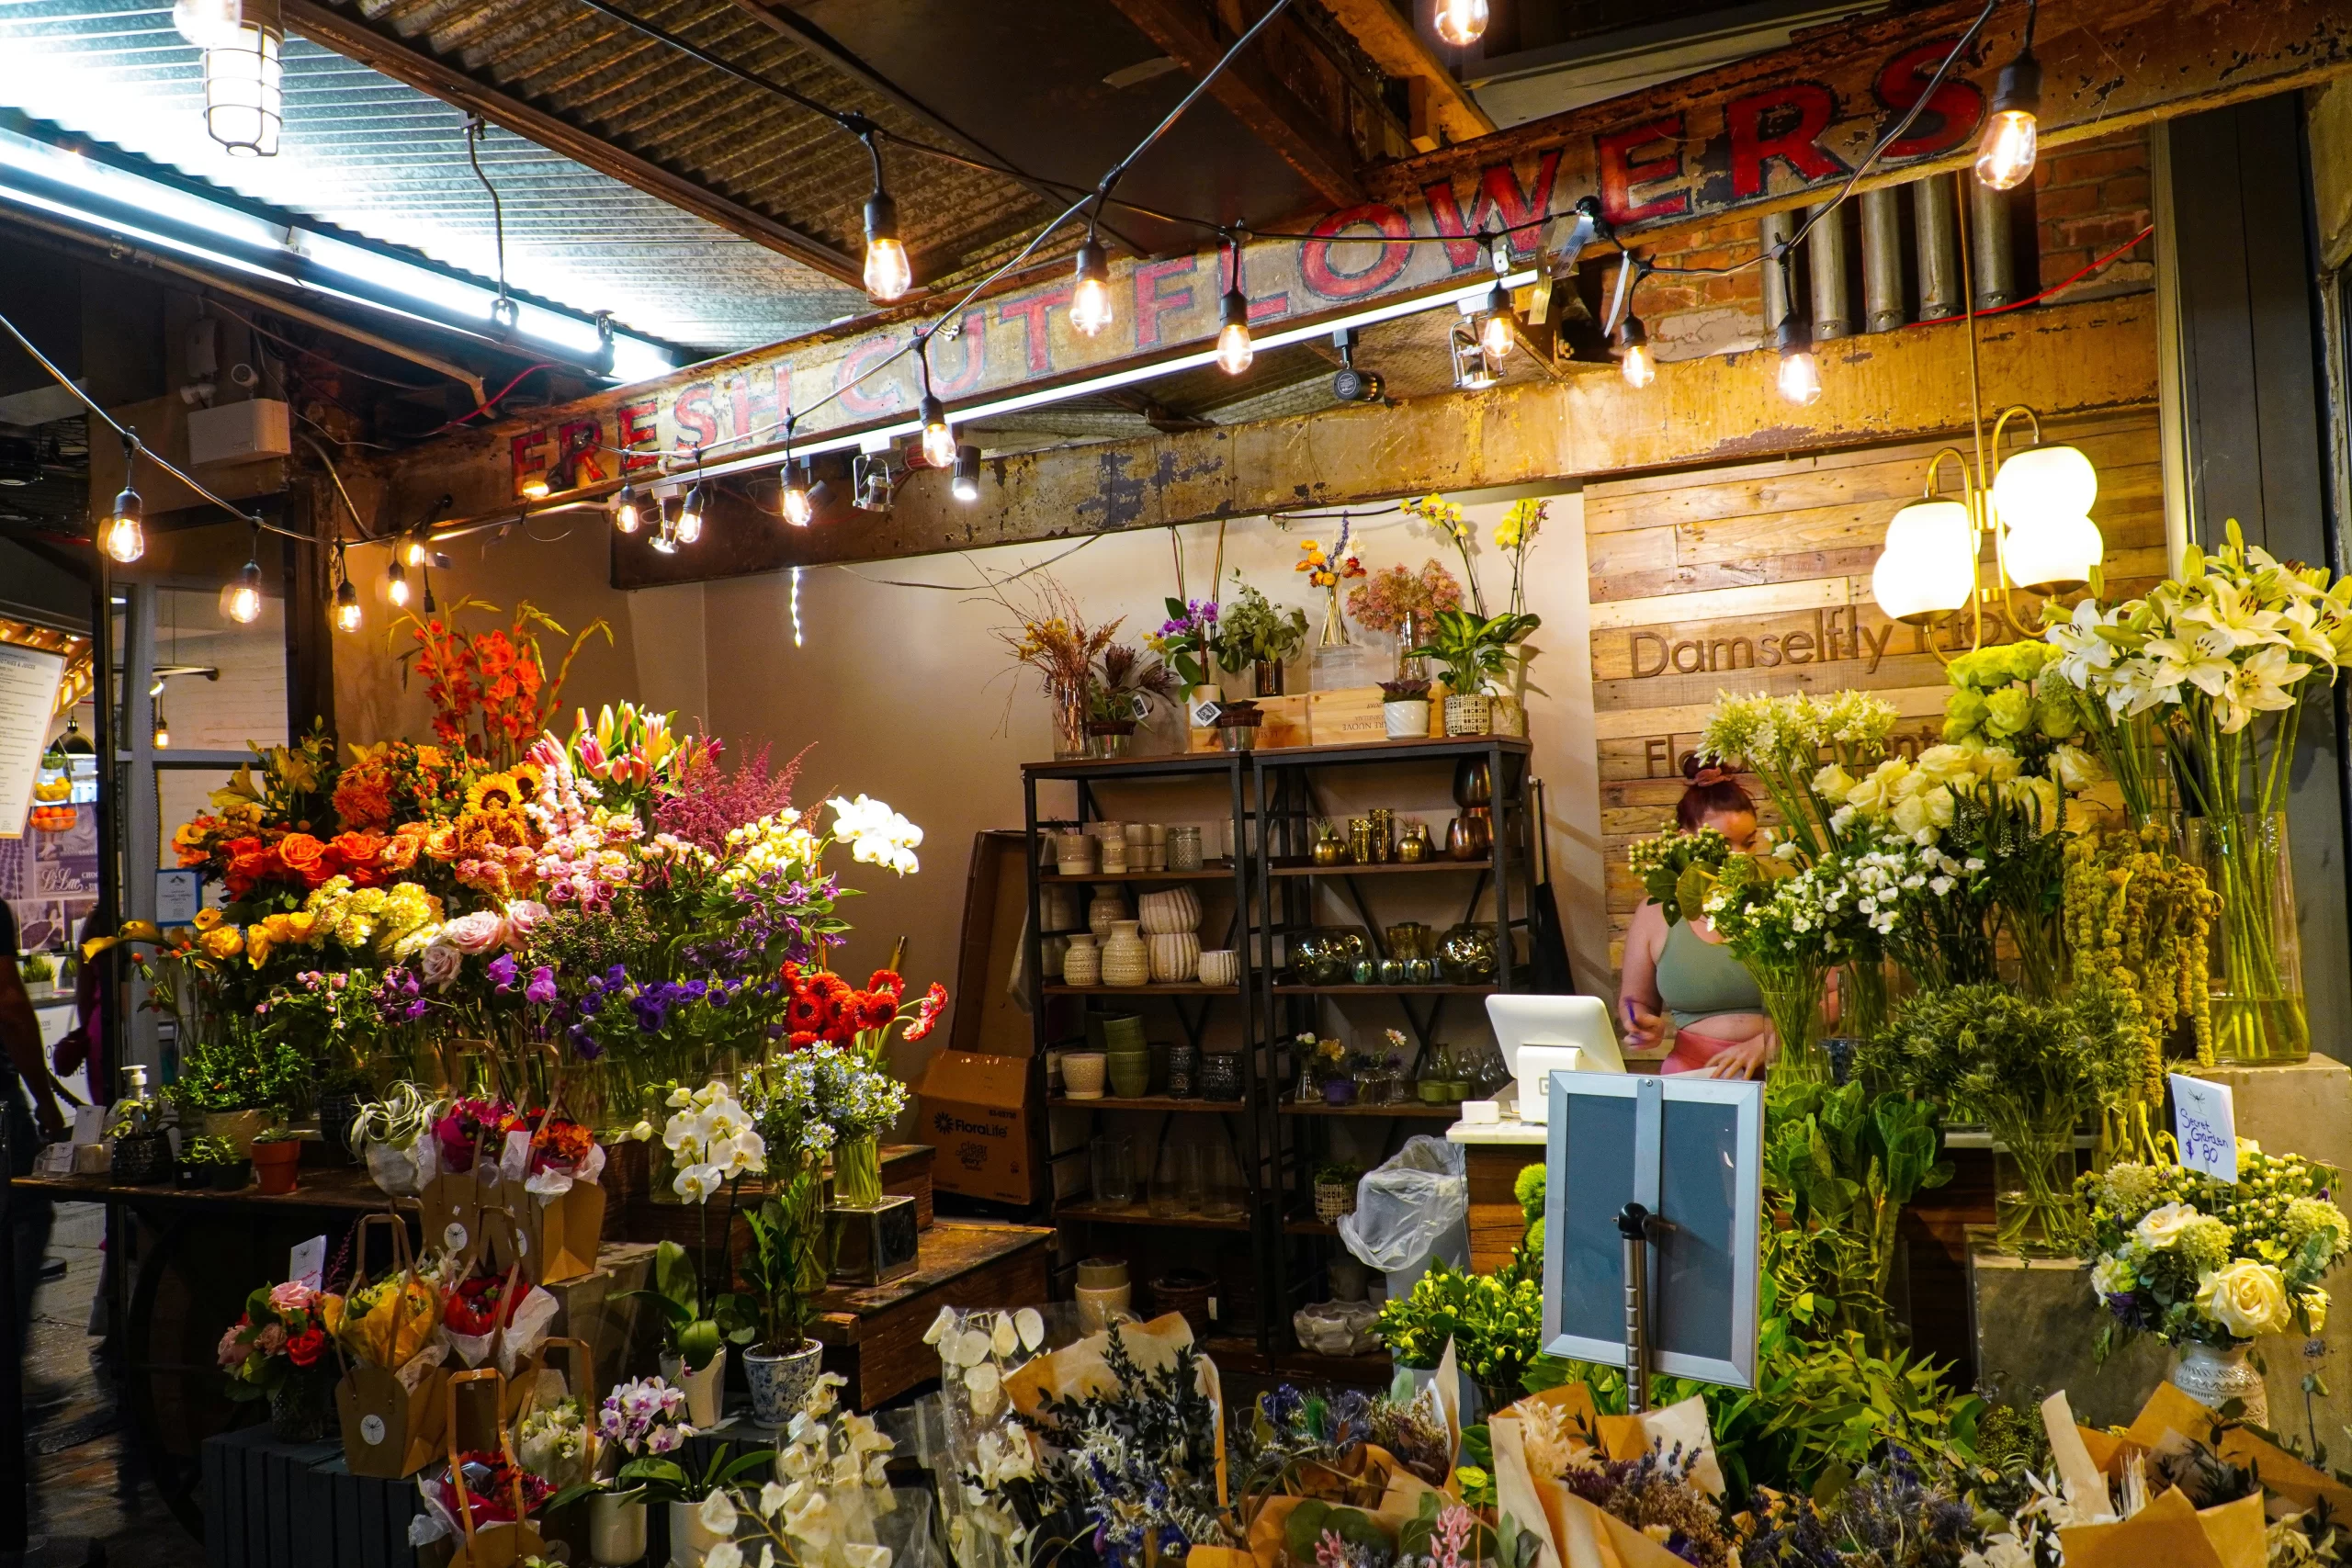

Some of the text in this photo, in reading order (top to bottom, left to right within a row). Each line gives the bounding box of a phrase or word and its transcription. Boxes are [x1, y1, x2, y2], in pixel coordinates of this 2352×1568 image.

[510, 360, 793, 501] FRESH
[835, 287, 1080, 416] CUT
[1133, 39, 1988, 349] FLOWERS
[1629, 605, 1894, 679] Damselfly
[1341, 721, 1372, 731] NUOVE
[2180, 1108, 2212, 1134] Secret
[2190, 1127, 2229, 1149] Garden
